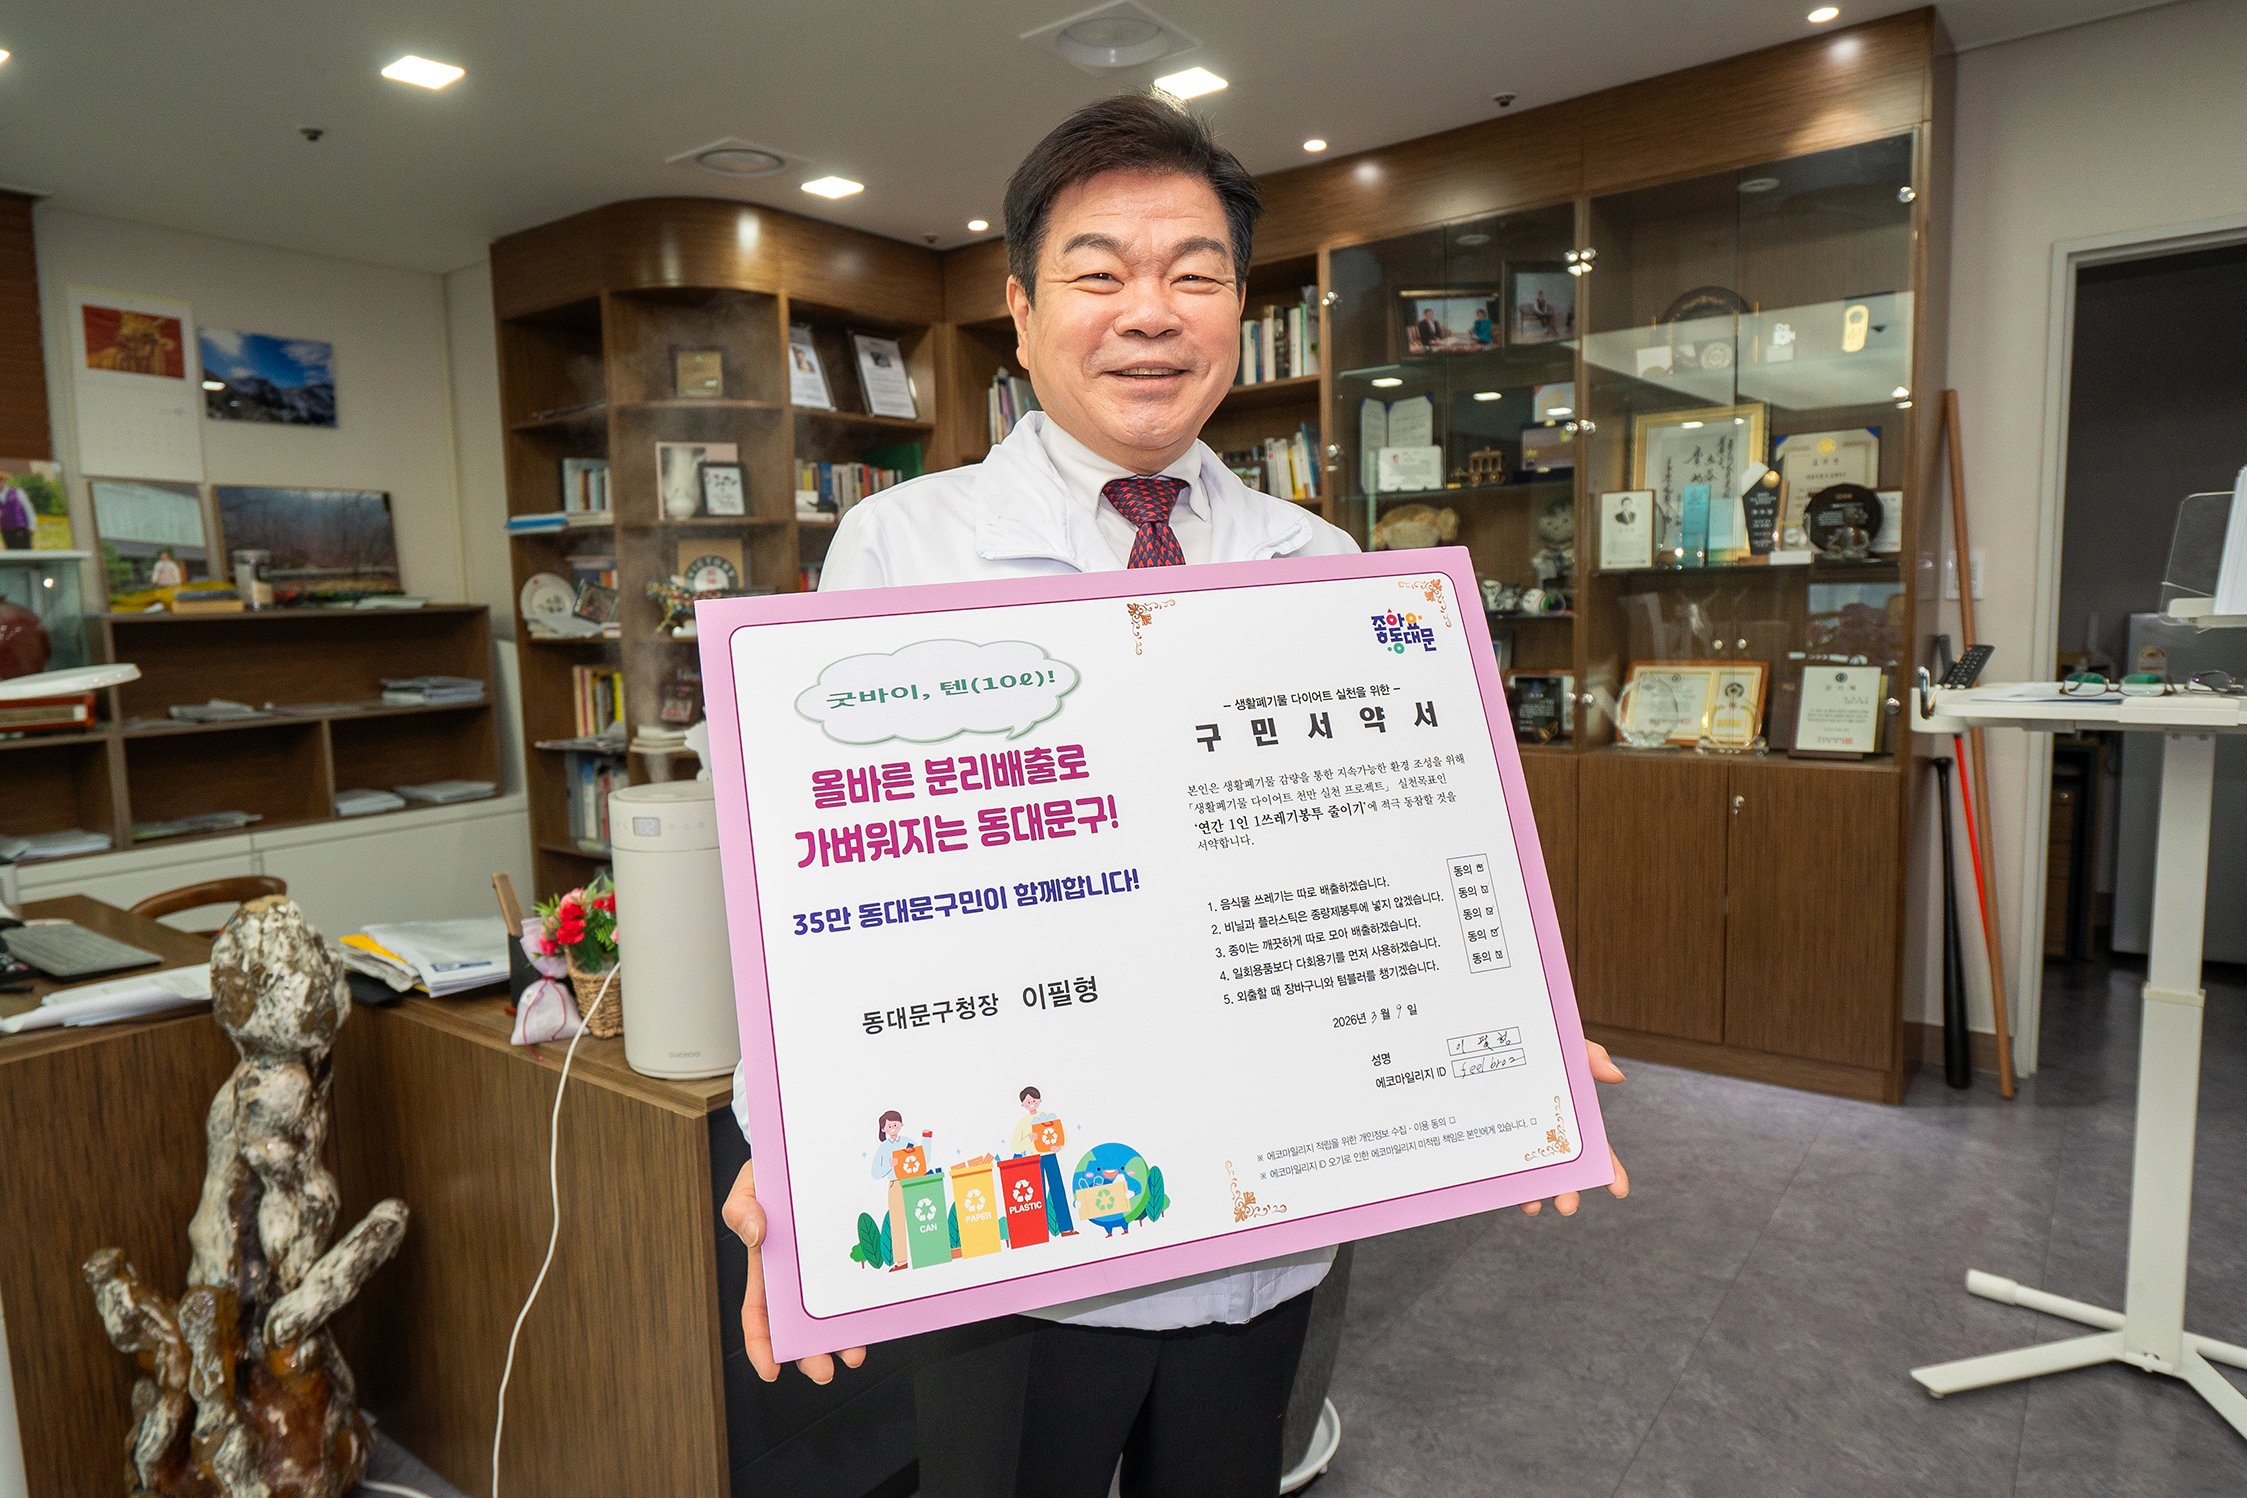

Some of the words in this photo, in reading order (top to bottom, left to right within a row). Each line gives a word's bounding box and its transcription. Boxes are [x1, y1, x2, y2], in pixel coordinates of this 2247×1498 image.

[826, 684, 931, 709] 굿바이,
[1234, 694, 1287, 710] 생활폐기물
[1290, 690, 1333, 704] 다이어트
[1335, 686, 1366, 700] 실천을
[1369, 683, 1390, 696] 위한
[811, 761, 915, 809] 올바른
[924, 744, 1089, 796] 분리배출로
[1187, 782, 1219, 796] 본인은
[1222, 775, 1275, 792] 생활폐기물
[1278, 771, 1309, 785] 감량을
[1313, 768, 1333, 781] 통한
[1337, 762, 1387, 778] 지속가능한
[1389, 759, 1409, 772] 환경
[1413, 755, 1442, 768] 조성을
[1445, 752, 1465, 765] 위해
[1250, 792, 1293, 807] 다이어트
[1296, 788, 1317, 801] 천만
[1320, 785, 1341, 798] 실천
[1398, 772, 1447, 789] 실천목표인
[1229, 815, 1249, 830] 1인
[1253, 806, 1324, 827] 1쓰레기봉투
[1381, 798, 1400, 810] 적극
[1403, 793, 1433, 808] 동참할
[1436, 790, 1456, 804] 것을
[794, 814, 968, 868] 가벼워지는
[977, 794, 1119, 847] 동대문구!
[1197, 833, 1254, 851] 서약합니다.
[1453, 864, 1473, 877] 동의
[792, 906, 851, 935] 35만
[858, 885, 1007, 928] 동대문구민이
[1013, 868, 1139, 907] 함께합니다!
[1207, 902, 1217, 911] 1.
[1220, 895, 1250, 910] 음식물
[1254, 890, 1294, 905] 쓰레기는
[1296, 886, 1317, 899] 따로
[1319, 876, 1390, 895] 배출하겠습니다.
[1458, 885, 1477, 898] 동의
[1211, 924, 1221, 935] 2.
[1224, 917, 1255, 933] 비닐과
[1257, 910, 1308, 928] 플라스틱은
[1310, 901, 1369, 920] 종량제봉투에
[1371, 898, 1391, 911] 넣지
[1393, 890, 1444, 908] 않겠습니다.
[1462, 907, 1482, 920] 동의
[1215, 947, 1225, 958] 3.
[1228, 941, 1259, 956] 종이는
[1262, 934, 1302, 950] 깨끗하게
[1305, 931, 1326, 944] 따로
[1328, 927, 1348, 940] 모아
[1350, 916, 1421, 936] 배출하겠습니다.
[1467, 928, 1487, 942] 동의
[1219, 970, 1229, 980] 4.
[1232, 959, 1293, 979] 일회용품보다
[1295, 951, 1345, 969] 다회용기를
[1348, 947, 1368, 961] 먼저
[1371, 936, 1440, 957] 사용하겠습니다.
[1472, 950, 1492, 964] 동의
[1223, 993, 1234, 1004] 5.
[1236, 987, 1267, 1002] 외출할
[1270, 984, 1281, 996] 때
[1284, 976, 1334, 995] 장바구니와
[1336, 969, 1376, 986] 텀블러를
[1379, 959, 1439, 979] 챙기겠습니다.
[862, 992, 998, 1035] 동대문구청장
[1022, 975, 1098, 1010] 이필형
[1332, 1011, 1367, 1028] 2026년
[1380, 1007, 1391, 1020] 월
[1406, 1003, 1418, 1016] 일
[1371, 1052, 1391, 1066] 성명
[1375, 1067, 1434, 1088] 에코마일리지
[1436, 1066, 1446, 1077] ID
[1266, 1143, 1314, 1160] 에코마일리지
[1315, 1138, 1339, 1151] 적립을
[1341, 1134, 1357, 1146] 위한
[1359, 1129, 1389, 1142] 개인정보
[1391, 1124, 1407, 1136] 수집
[1413, 1120, 1429, 1131] 이용
[1430, 1117, 1446, 1129] 동의
[1269, 1160, 1317, 1178] 에코마일리지
[1318, 1159, 1326, 1168] ID
[1328, 1154, 1352, 1167] 오기로
[1353, 1150, 1369, 1162] 인한
[1370, 1140, 1417, 1157] 에코마일리지
[1417, 1135, 1440, 1148] 미적립
[1442, 1131, 1464, 1143] 책임은
[1466, 1125, 1496, 1139] 본인에게
[1496, 1119, 1528, 1133] 있습니다.
[965, 1211, 992, 1223] PAPER
[1009, 1201, 1043, 1214] PLASTIC
[920, 1223, 938, 1233] CAN
